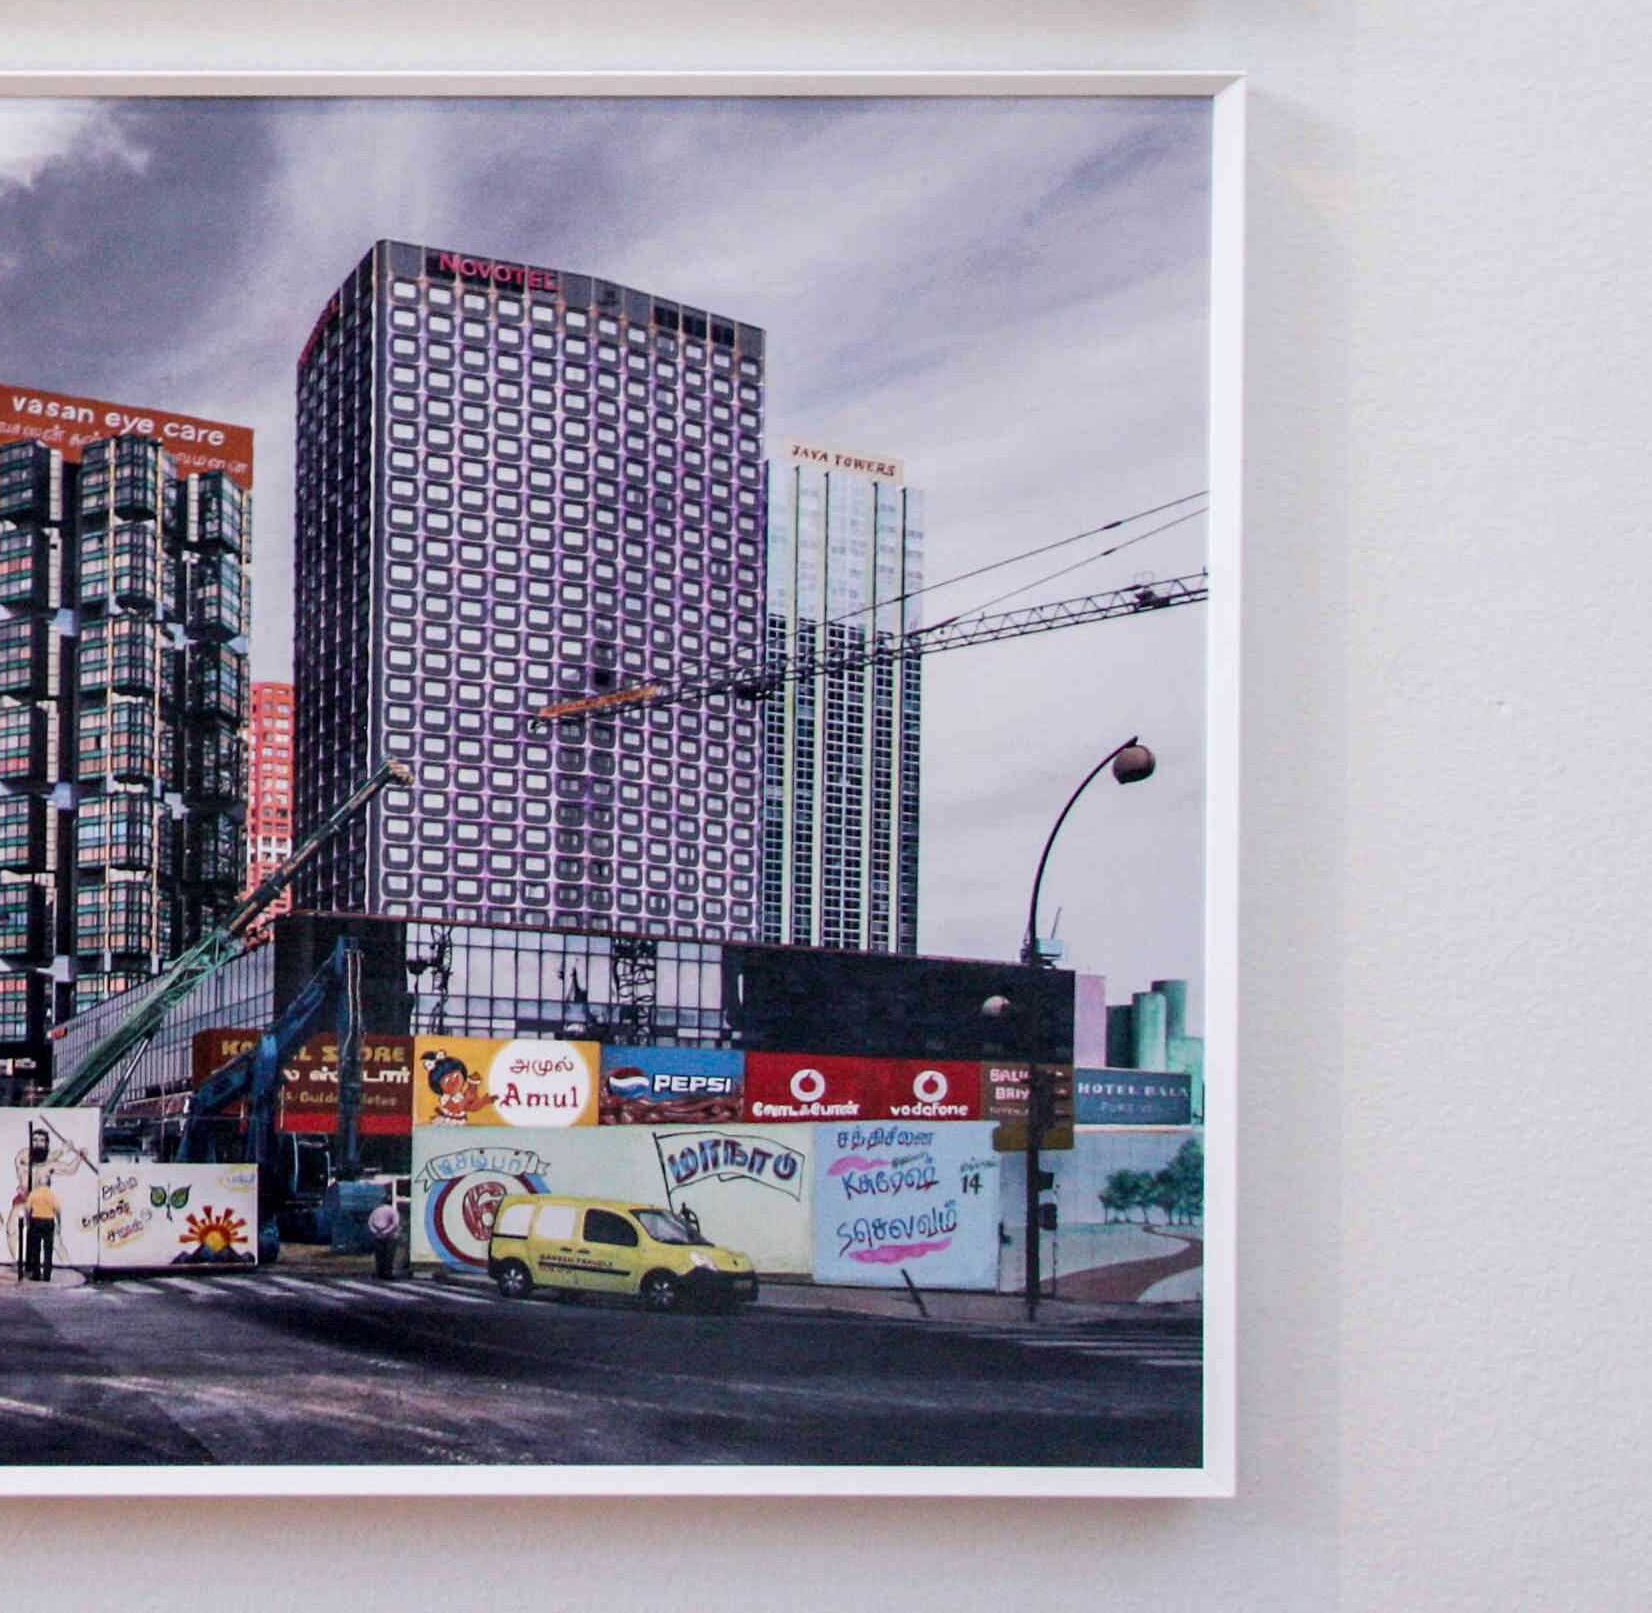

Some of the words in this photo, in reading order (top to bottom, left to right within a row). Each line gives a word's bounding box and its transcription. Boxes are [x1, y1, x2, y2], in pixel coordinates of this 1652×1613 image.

[11, 394, 96, 425] vasan
[104, 410, 154, 436] eye
[163, 420, 226, 446] care
[791, 443, 830, 464] JAYA
[833, 453, 896, 478] TOWERS
[509, 1055, 575, 1075] அமுல்
[652, 1073, 732, 1093] PEPSI
[1077, 1082, 1140, 1096] HOTEL
[499, 1081, 580, 1109] Amul
[890, 1101, 969, 1117] vodafone
[960, 1172, 984, 1195] 14
